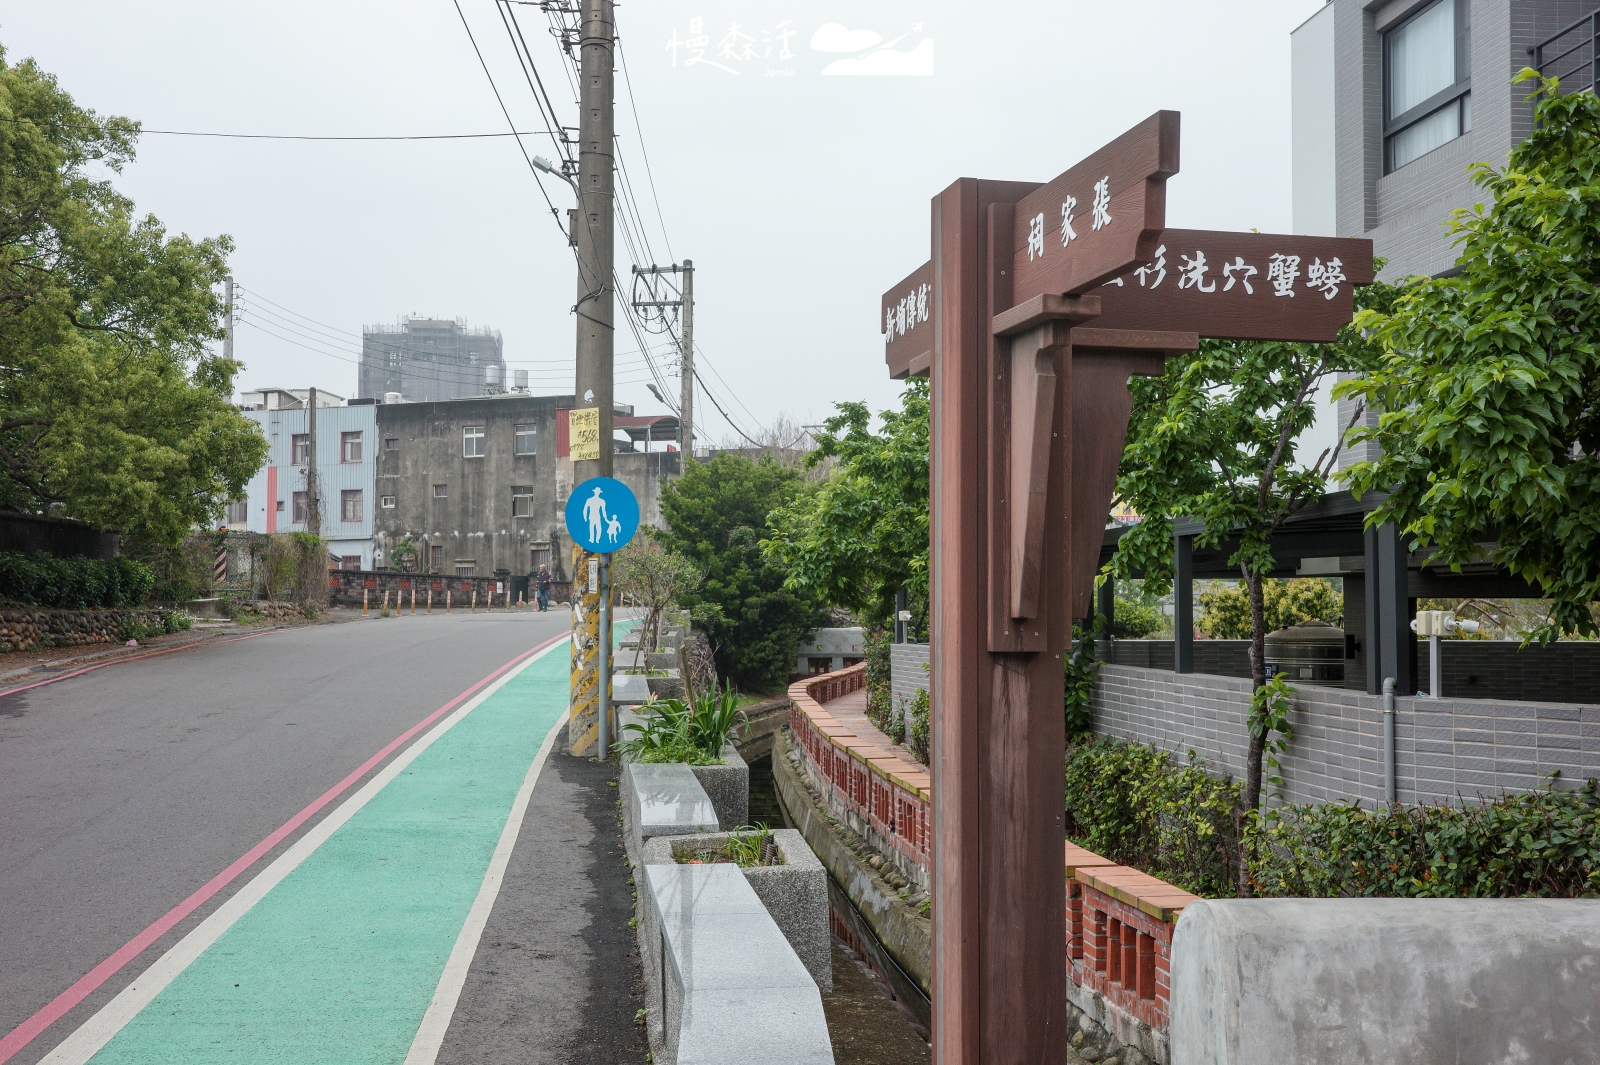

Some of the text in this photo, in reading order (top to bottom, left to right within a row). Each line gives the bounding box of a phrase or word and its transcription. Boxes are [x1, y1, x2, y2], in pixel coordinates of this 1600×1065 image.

[1101, 244, 1347, 301] 螃蟹穴洗衫
[885, 283, 932, 344] 新埔傳統
